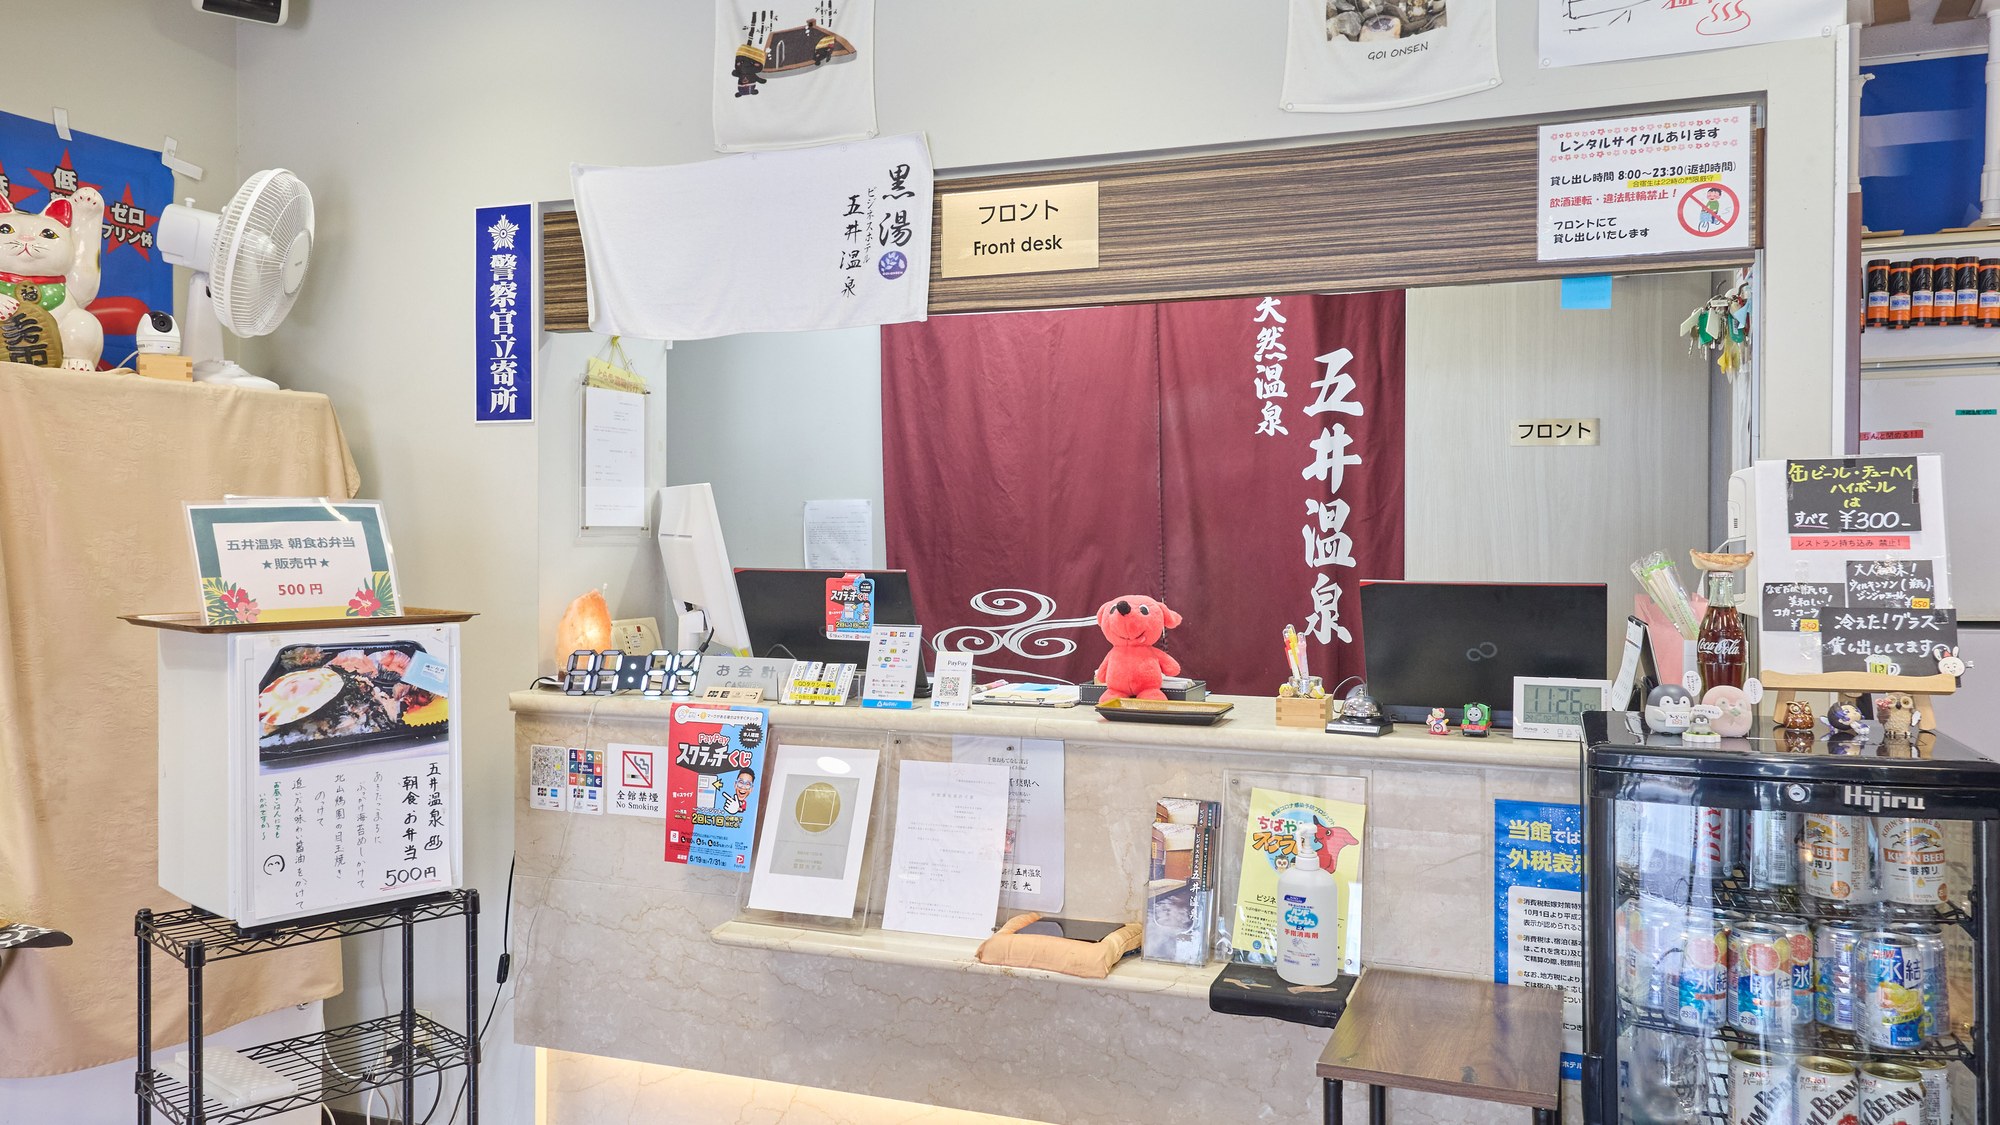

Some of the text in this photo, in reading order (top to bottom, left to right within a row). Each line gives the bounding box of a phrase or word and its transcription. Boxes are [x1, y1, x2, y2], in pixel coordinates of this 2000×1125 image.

[1367, 41, 1429, 61] GOI ONSEN
[1559, 127, 1720, 153] レンタルサイクルあります
[1550, 171, 1614, 187] 貸し出し時間
[111, 203, 145, 226] ゼロ
[879, 164, 915, 247] 黒湯
[978, 200, 1059, 224] フロント
[863, 186, 878, 263] ビジネスホテル
[1554, 217, 1617, 230] フロントにて
[102, 222, 154, 248] プリン体
[1553, 227, 1650, 244] 貸し出しいたします
[839, 194, 866, 298] 五井温泉
[973, 234, 1062, 256] Front desk
[489, 254, 518, 414] 警察官立寄所
[1254, 297, 1288, 436] 天然温泉
[1518, 423, 1592, 439] フロント
[1789, 463, 1914, 483] 缶ビール・チューハイ
[1302, 348, 1364, 644] 五井温泉
[1830, 481, 1896, 494] ハイボール
[1844, 497, 1861, 508] は
[1794, 511, 1829, 526] すべて
[226, 536, 356, 551] 五井温泉 朝食お弁当
[1797, 538, 1874, 548] レストラン持ち込み
[278, 583, 323, 596] 500 円
[1773, 608, 1819, 618] コカ・コーラ
[1697, 638, 1740, 655] Coca-Cola
[716, 664, 776, 678] お会計
[699, 733, 729, 746] PayPay
[676, 743, 752, 768] スクラッチくじ
[427, 762, 444, 827] 五井温泉
[617, 790, 659, 803] 全館禁煙
[1844, 786, 1926, 813] Hijiru
[616, 801, 659, 812] No Smoking
[402, 776, 420, 860] 朝食お弁当
[1922, 853, 1945, 862] BEER
[385, 866, 436, 887] 500円
[1898, 866, 1939, 876] 一番搾り
[1284, 928, 1319, 939] 手指消毒剤
[1880, 959, 1920, 982] 氷結
